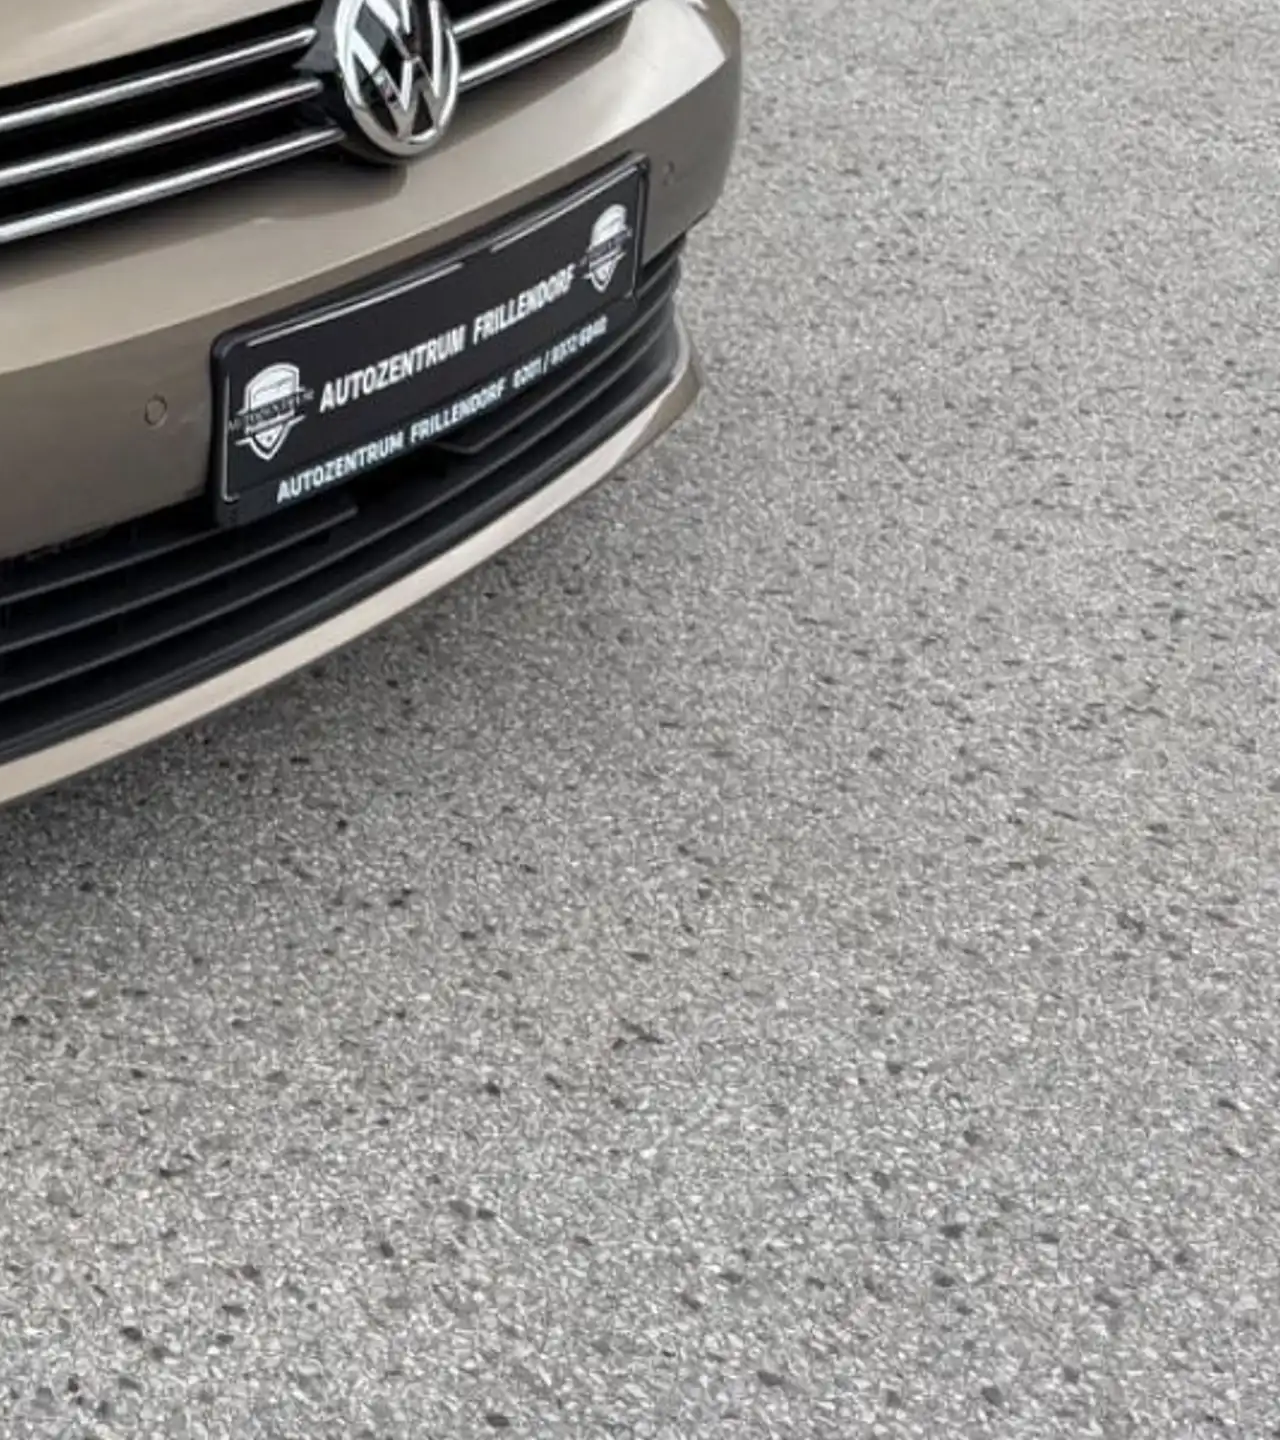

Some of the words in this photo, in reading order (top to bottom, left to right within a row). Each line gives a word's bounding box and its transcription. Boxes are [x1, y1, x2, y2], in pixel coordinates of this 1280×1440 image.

[319, 323, 467, 414] AUTOZENTRUM
[472, 263, 576, 345] FRILLENDORF
[276, 431, 405, 504] AUTOZENTRUM
[409, 376, 507, 444] FRILLENDORF
